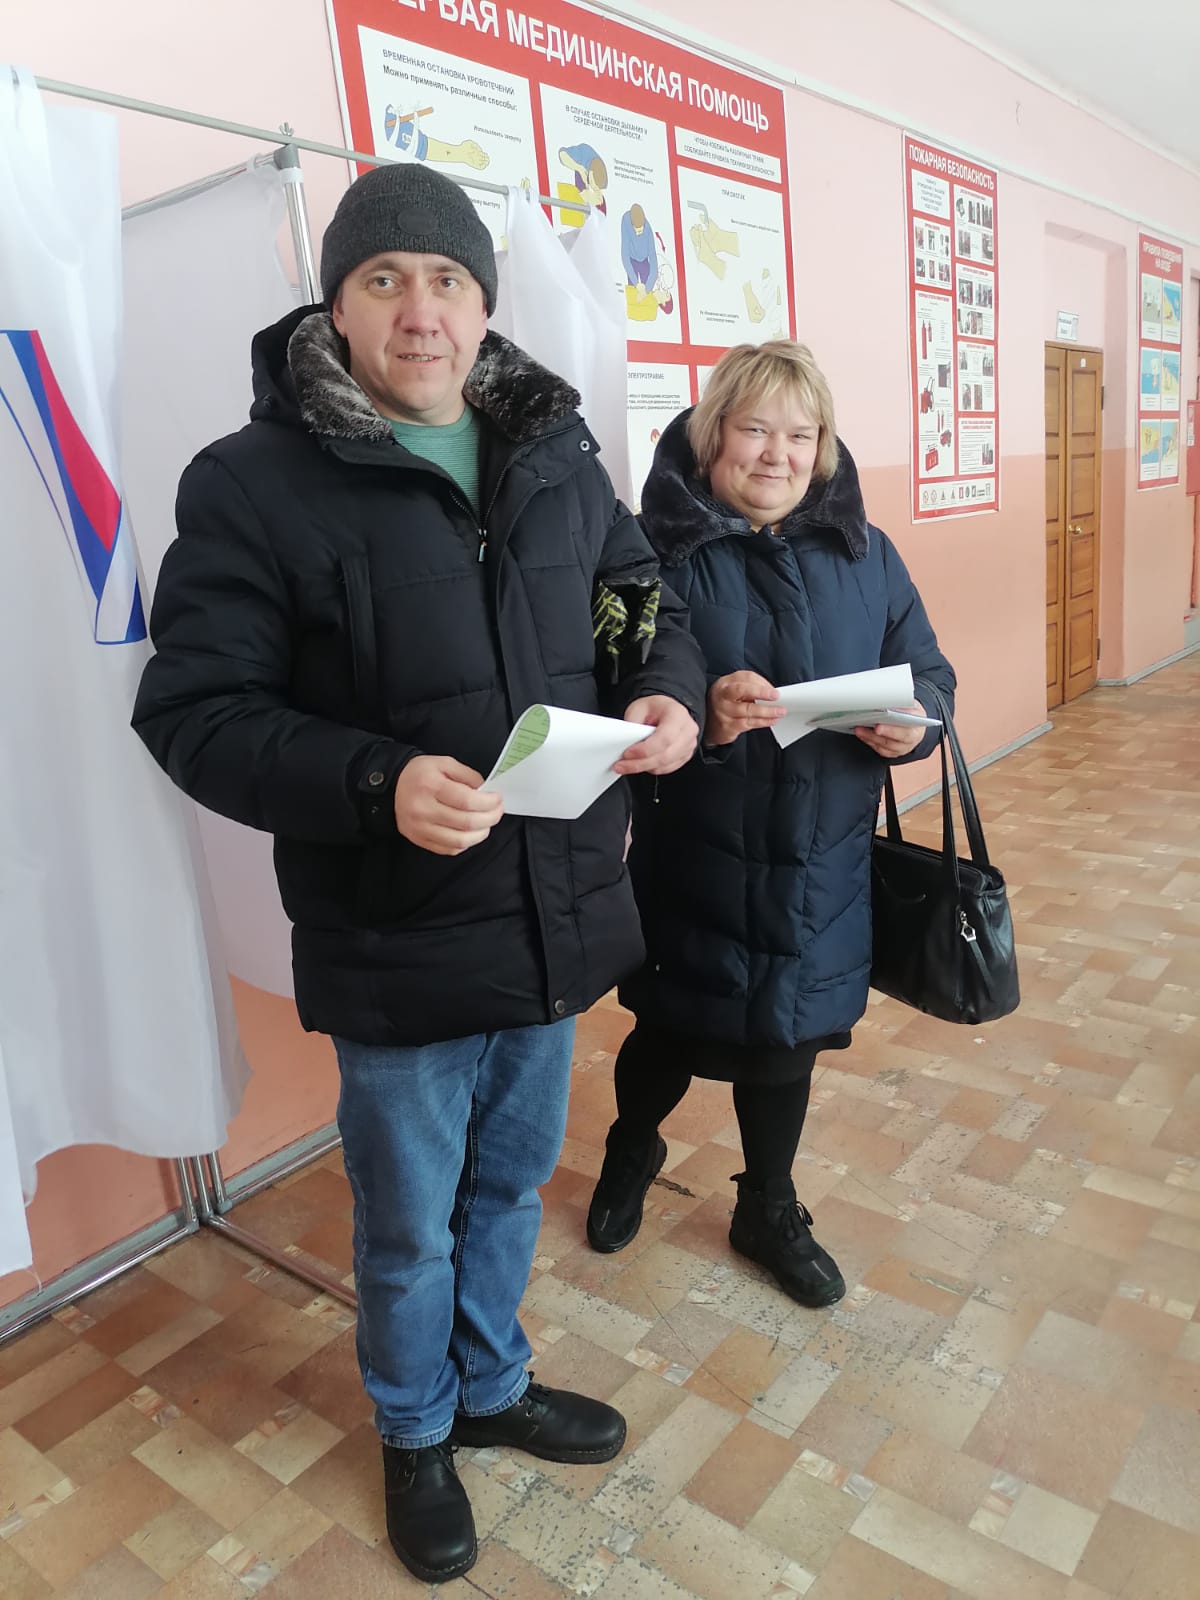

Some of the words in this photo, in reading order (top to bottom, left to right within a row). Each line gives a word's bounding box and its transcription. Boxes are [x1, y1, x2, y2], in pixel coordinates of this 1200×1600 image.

[383, 49, 426, 69] ВРЕМЕННАЯ
[427, 60, 466, 82] ОСТАНОВКА
[467, 75, 515, 95] КРОВОТЕЧЕНИЙ
[383, 65, 409, 80] Можно
[410, 74, 449, 92] применять
[450, 86, 487, 103] различные
[392, 0, 499, 38] ВАЯ
[506, 8, 683, 102] МЕДИЦИНСКАЯ
[687, 77, 769, 134] ПОМОЩЬ
[909, 144, 947, 173] ПОЖАРНАЯ
[947, 159, 994, 190] БЕЗОПАСНОСТЬ
